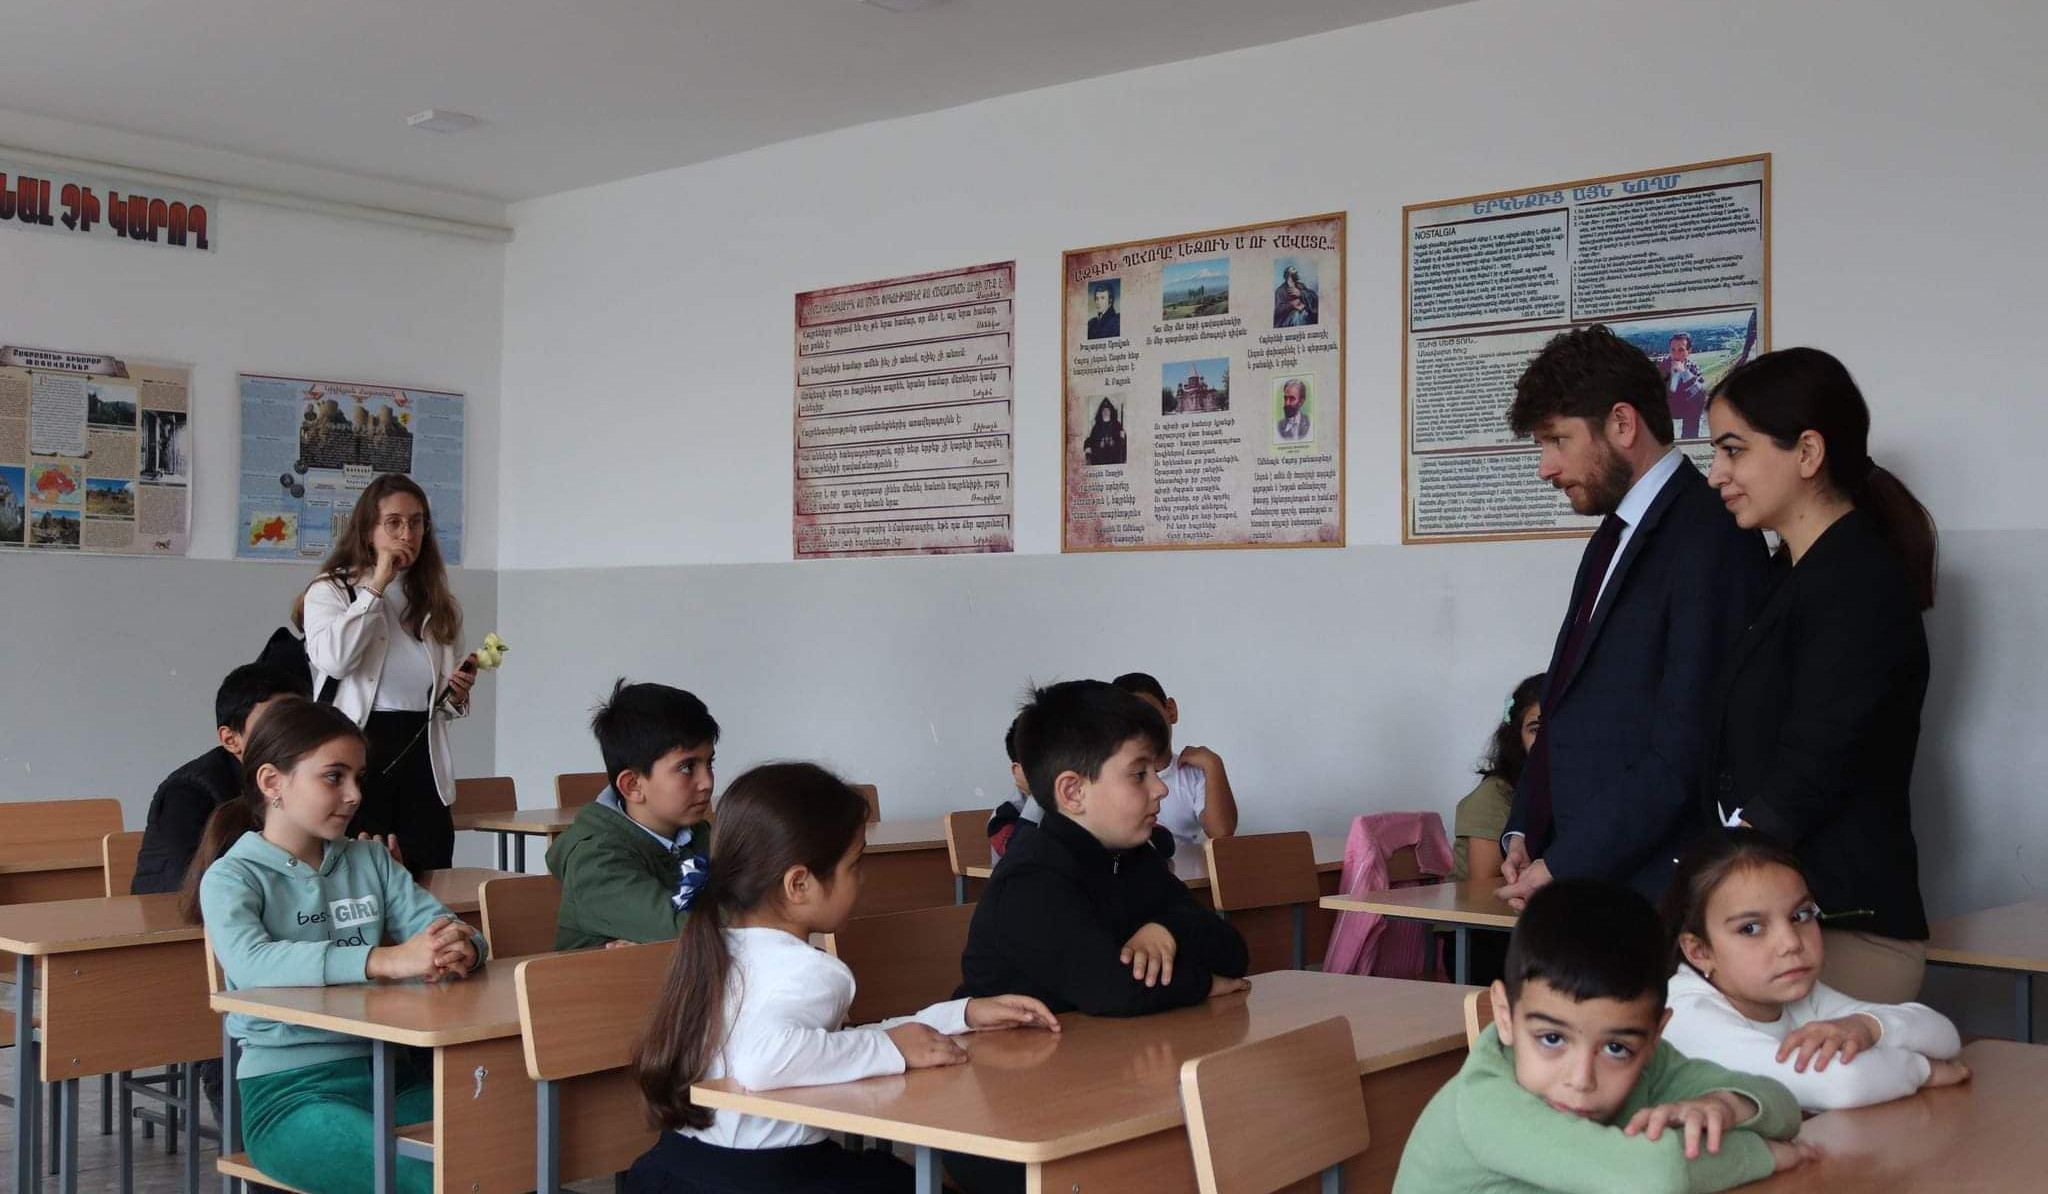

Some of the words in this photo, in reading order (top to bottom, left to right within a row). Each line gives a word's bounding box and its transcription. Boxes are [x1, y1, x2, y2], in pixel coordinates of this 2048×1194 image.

[1572, 184, 1613, 201] ԱՅՆ
[1621, 174, 1680, 194] ԿՈՂՄ
[61, 183, 101, 232] ՉԻ
[108, 191, 209, 250] ԿԱՐՈՂ
[1415, 226, 1456, 240] NOSTALGIA
[1072, 260, 1119, 282] ԱԶԳԻՆ
[1122, 249, 1172, 268] ՊԱՀՈՂԸ
[1178, 241, 1229, 258] ԼԵԶՈՒՆ
[1236, 237, 1245, 250] Ա
[1249, 236, 1268, 250] ՈՒ
[1272, 234, 1336, 252] ՀԱՎԱՏԸ...
[334, 902, 378, 922] GIRL
